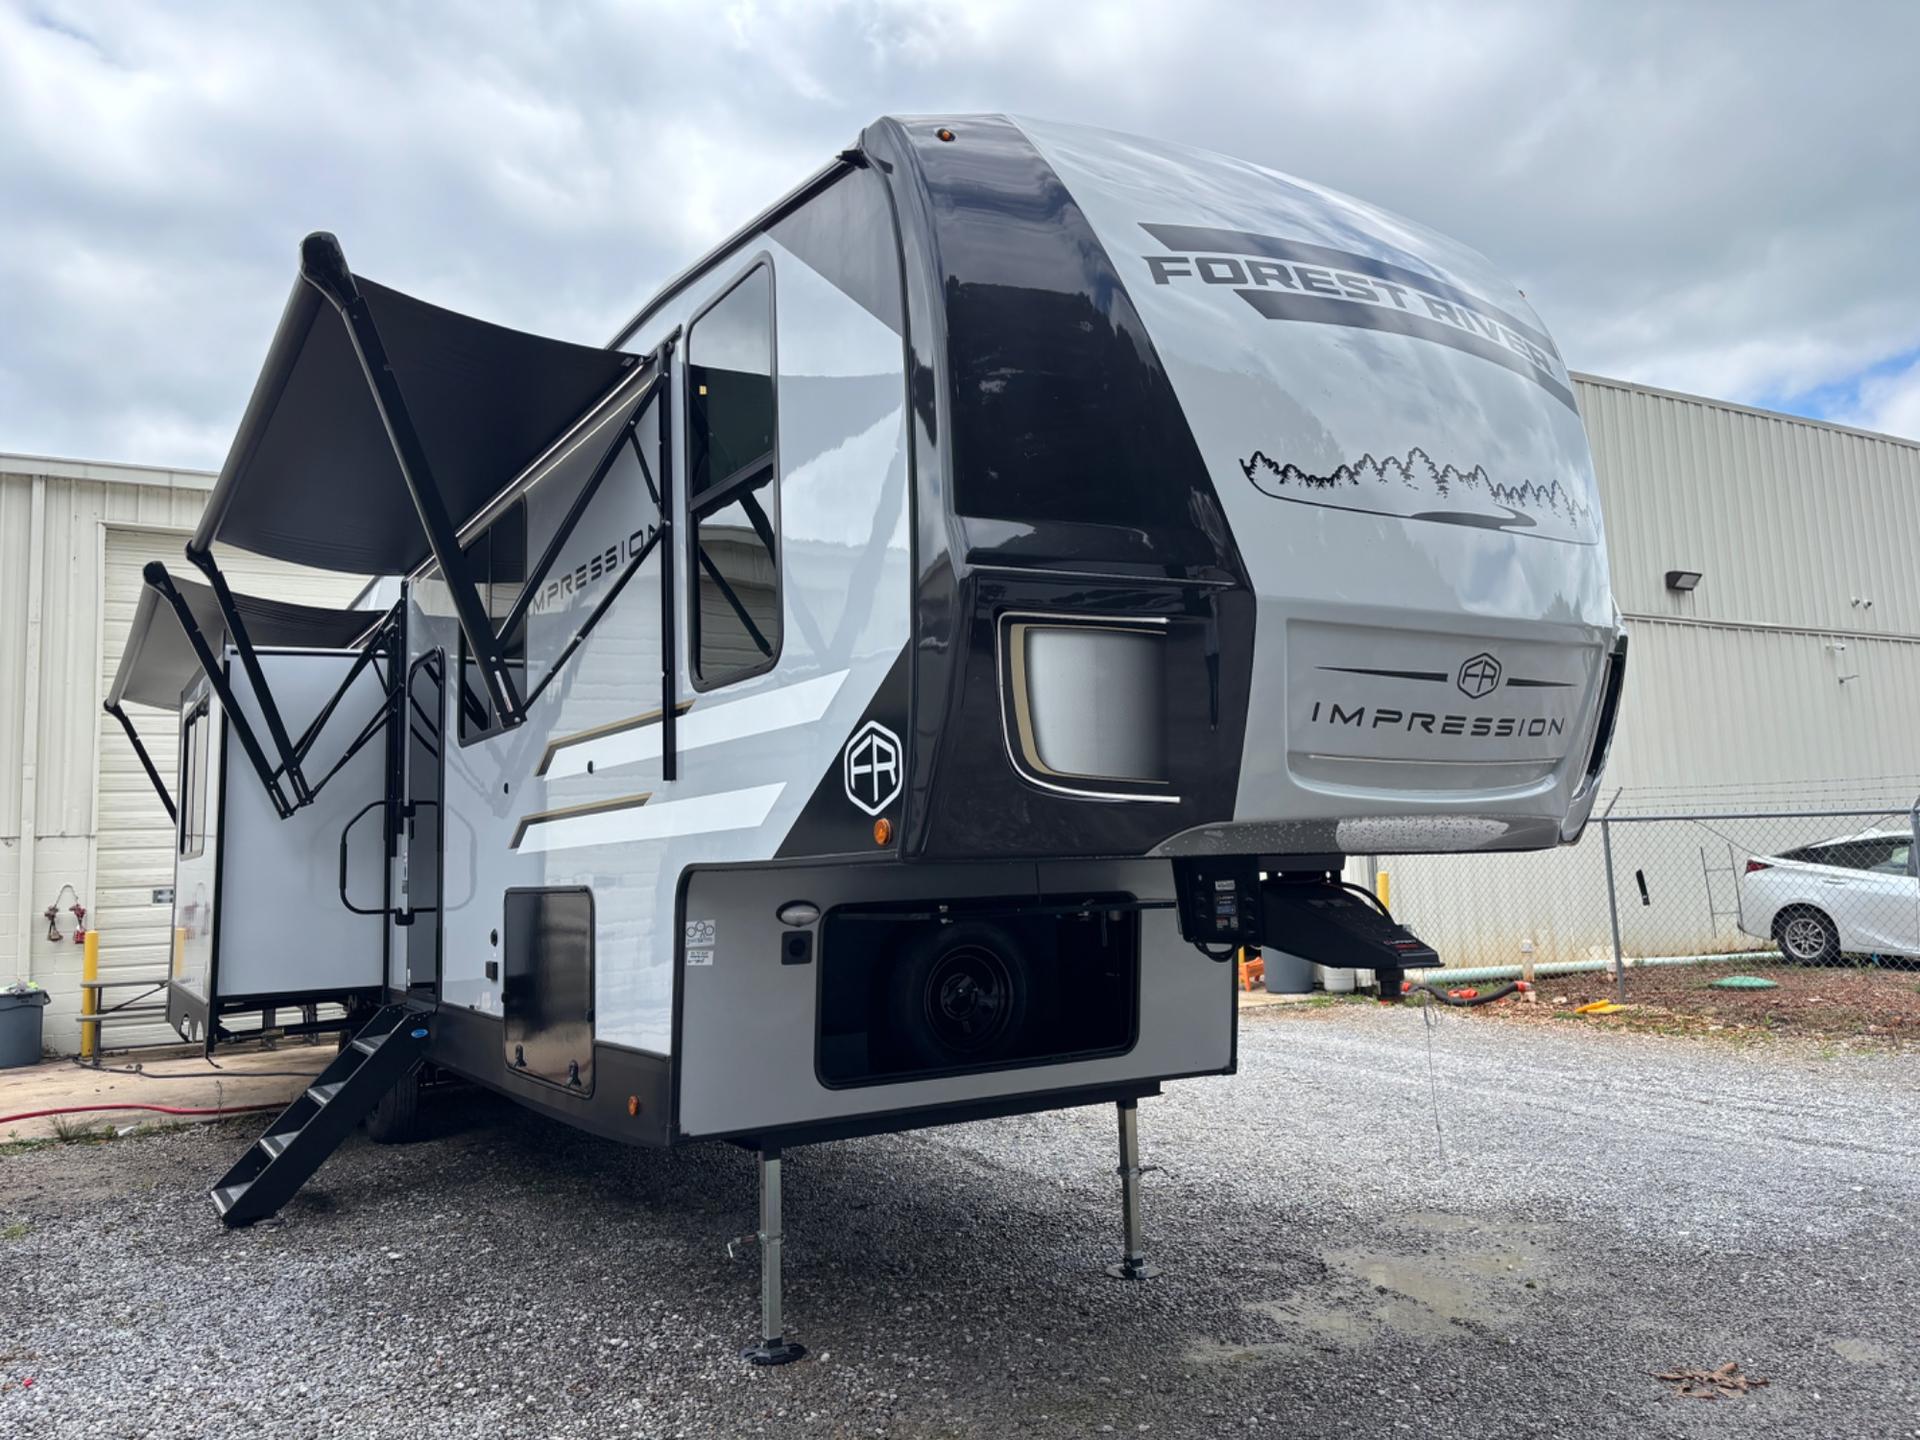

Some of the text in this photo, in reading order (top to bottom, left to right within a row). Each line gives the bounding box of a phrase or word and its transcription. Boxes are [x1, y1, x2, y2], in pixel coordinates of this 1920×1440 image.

[1142, 255, 1556, 377] FOREST RIVER
[528, 523, 658, 617] MPRESSIO
[1311, 701, 1565, 737] IMPRESSION
